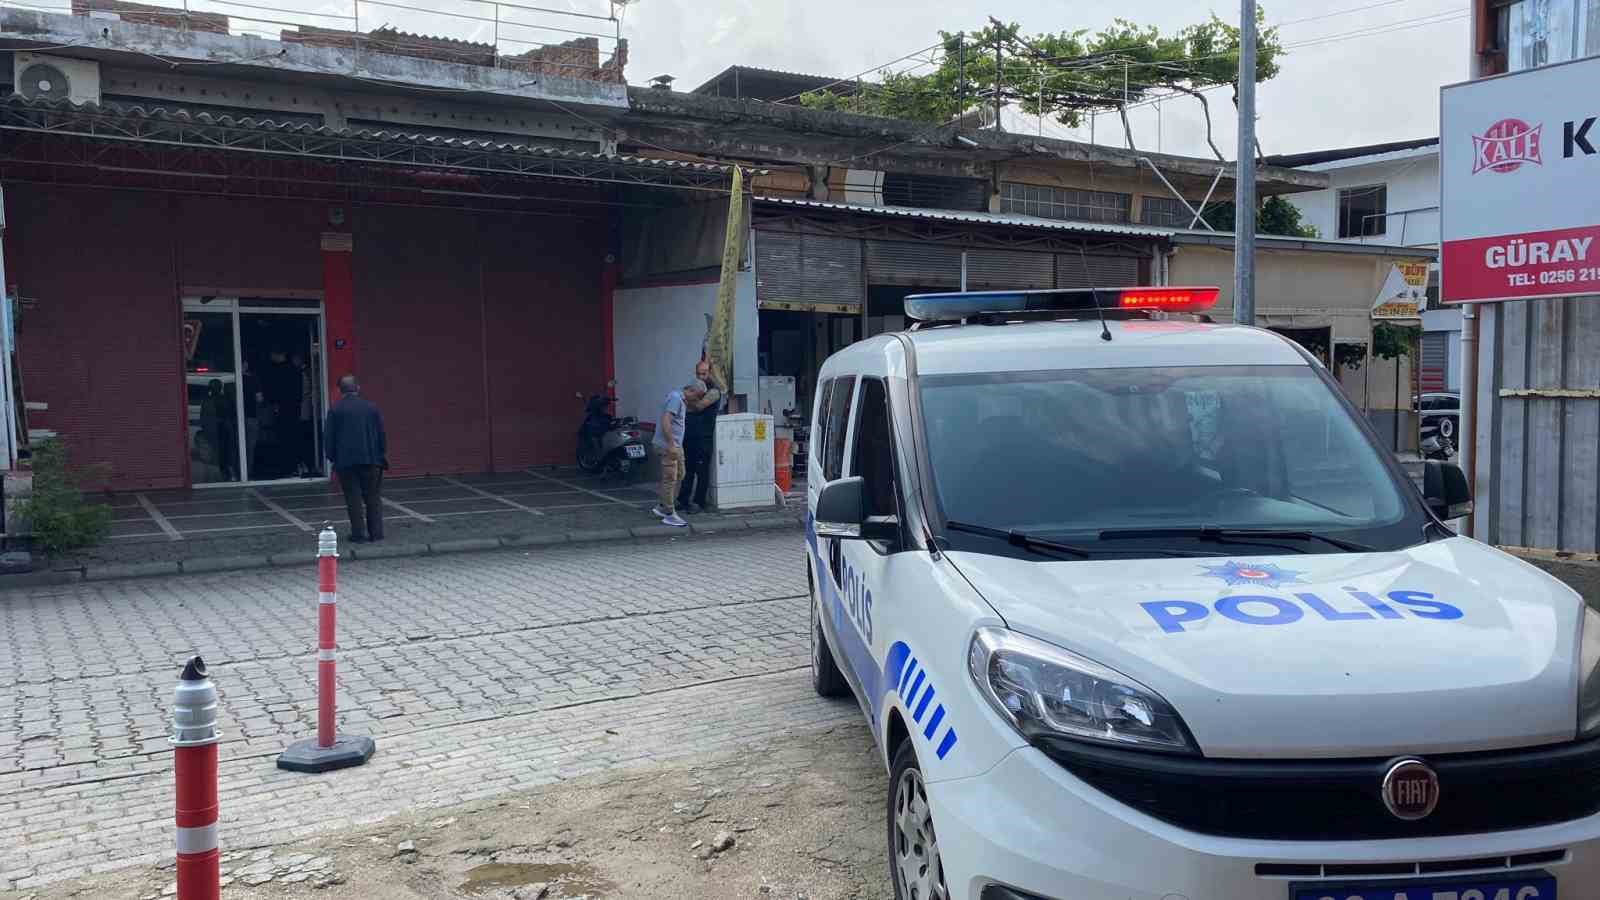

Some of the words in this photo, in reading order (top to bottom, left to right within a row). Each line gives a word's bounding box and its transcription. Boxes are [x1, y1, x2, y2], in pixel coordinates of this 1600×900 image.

[1474, 127, 1540, 171] KALE
[1485, 237, 1593, 268] GÜRAY
[1507, 272, 1535, 287] TEL:
[1540, 269, 1575, 284] 0256
[1138, 586, 1464, 633] POLİS
[1397, 779, 1428, 804] FIAT
